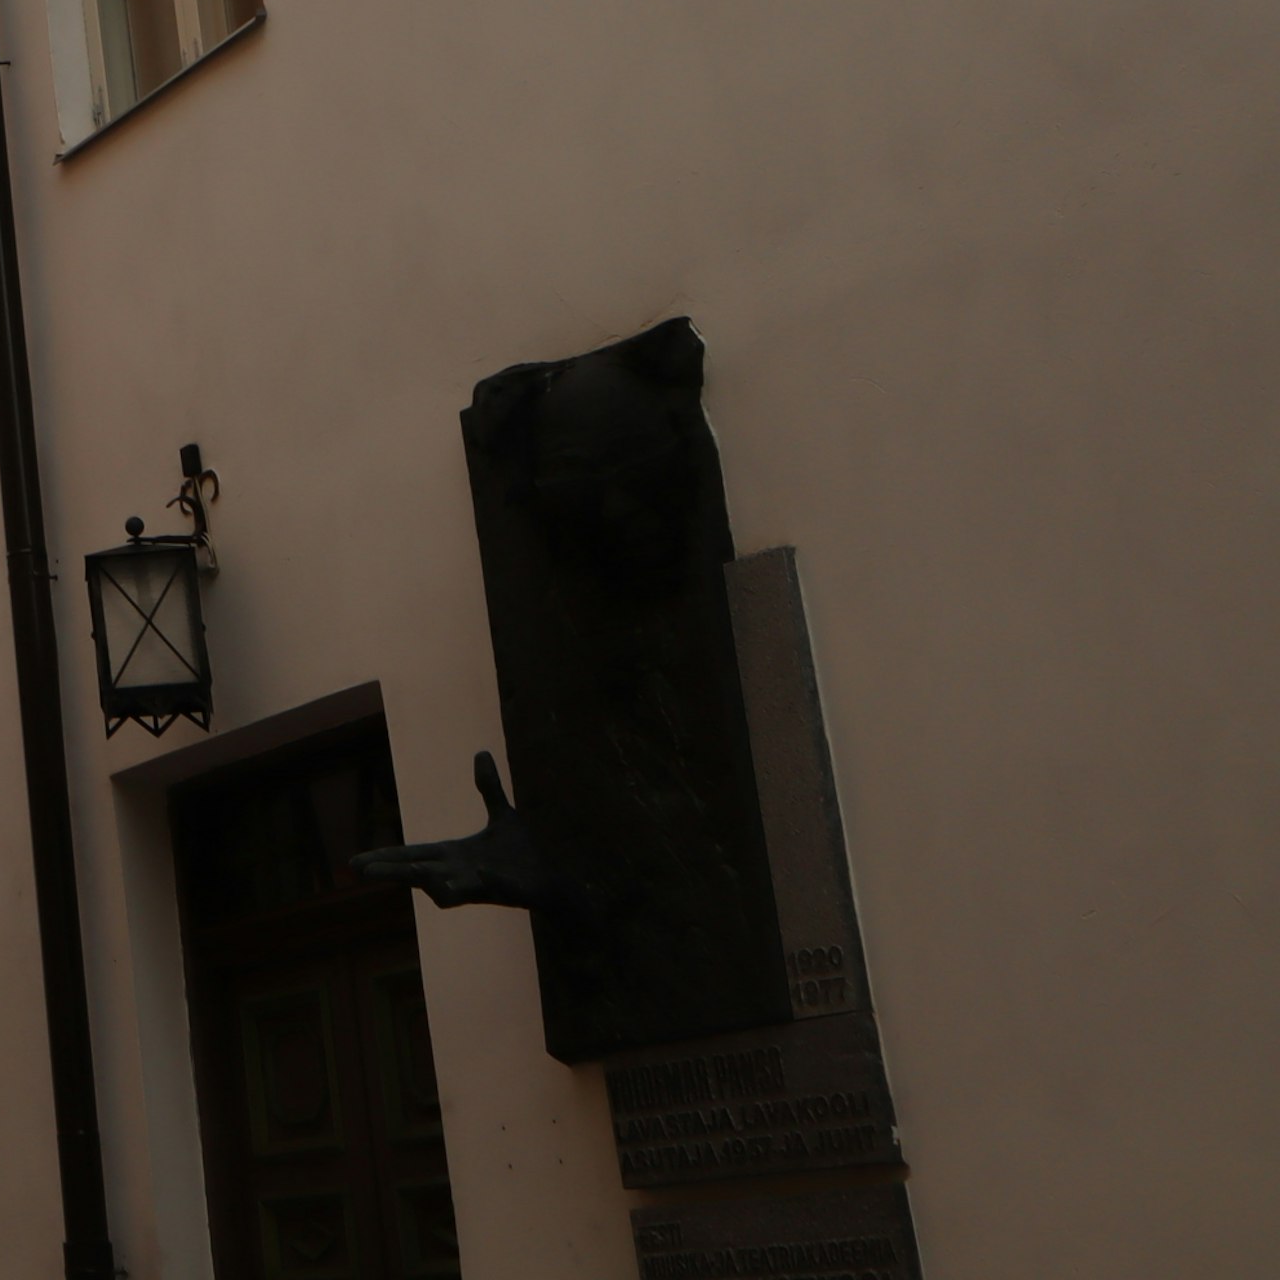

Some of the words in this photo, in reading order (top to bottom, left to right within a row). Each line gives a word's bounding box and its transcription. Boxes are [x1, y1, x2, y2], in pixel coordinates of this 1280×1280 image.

[787, 943, 845, 981] 1920
[792, 975, 847, 1008] 1977
[741, 1090, 872, 1130] LAVAKOOLI
[620, 1138, 722, 1176] ASUTAJA
[638, 1222, 684, 1252] EESTI
